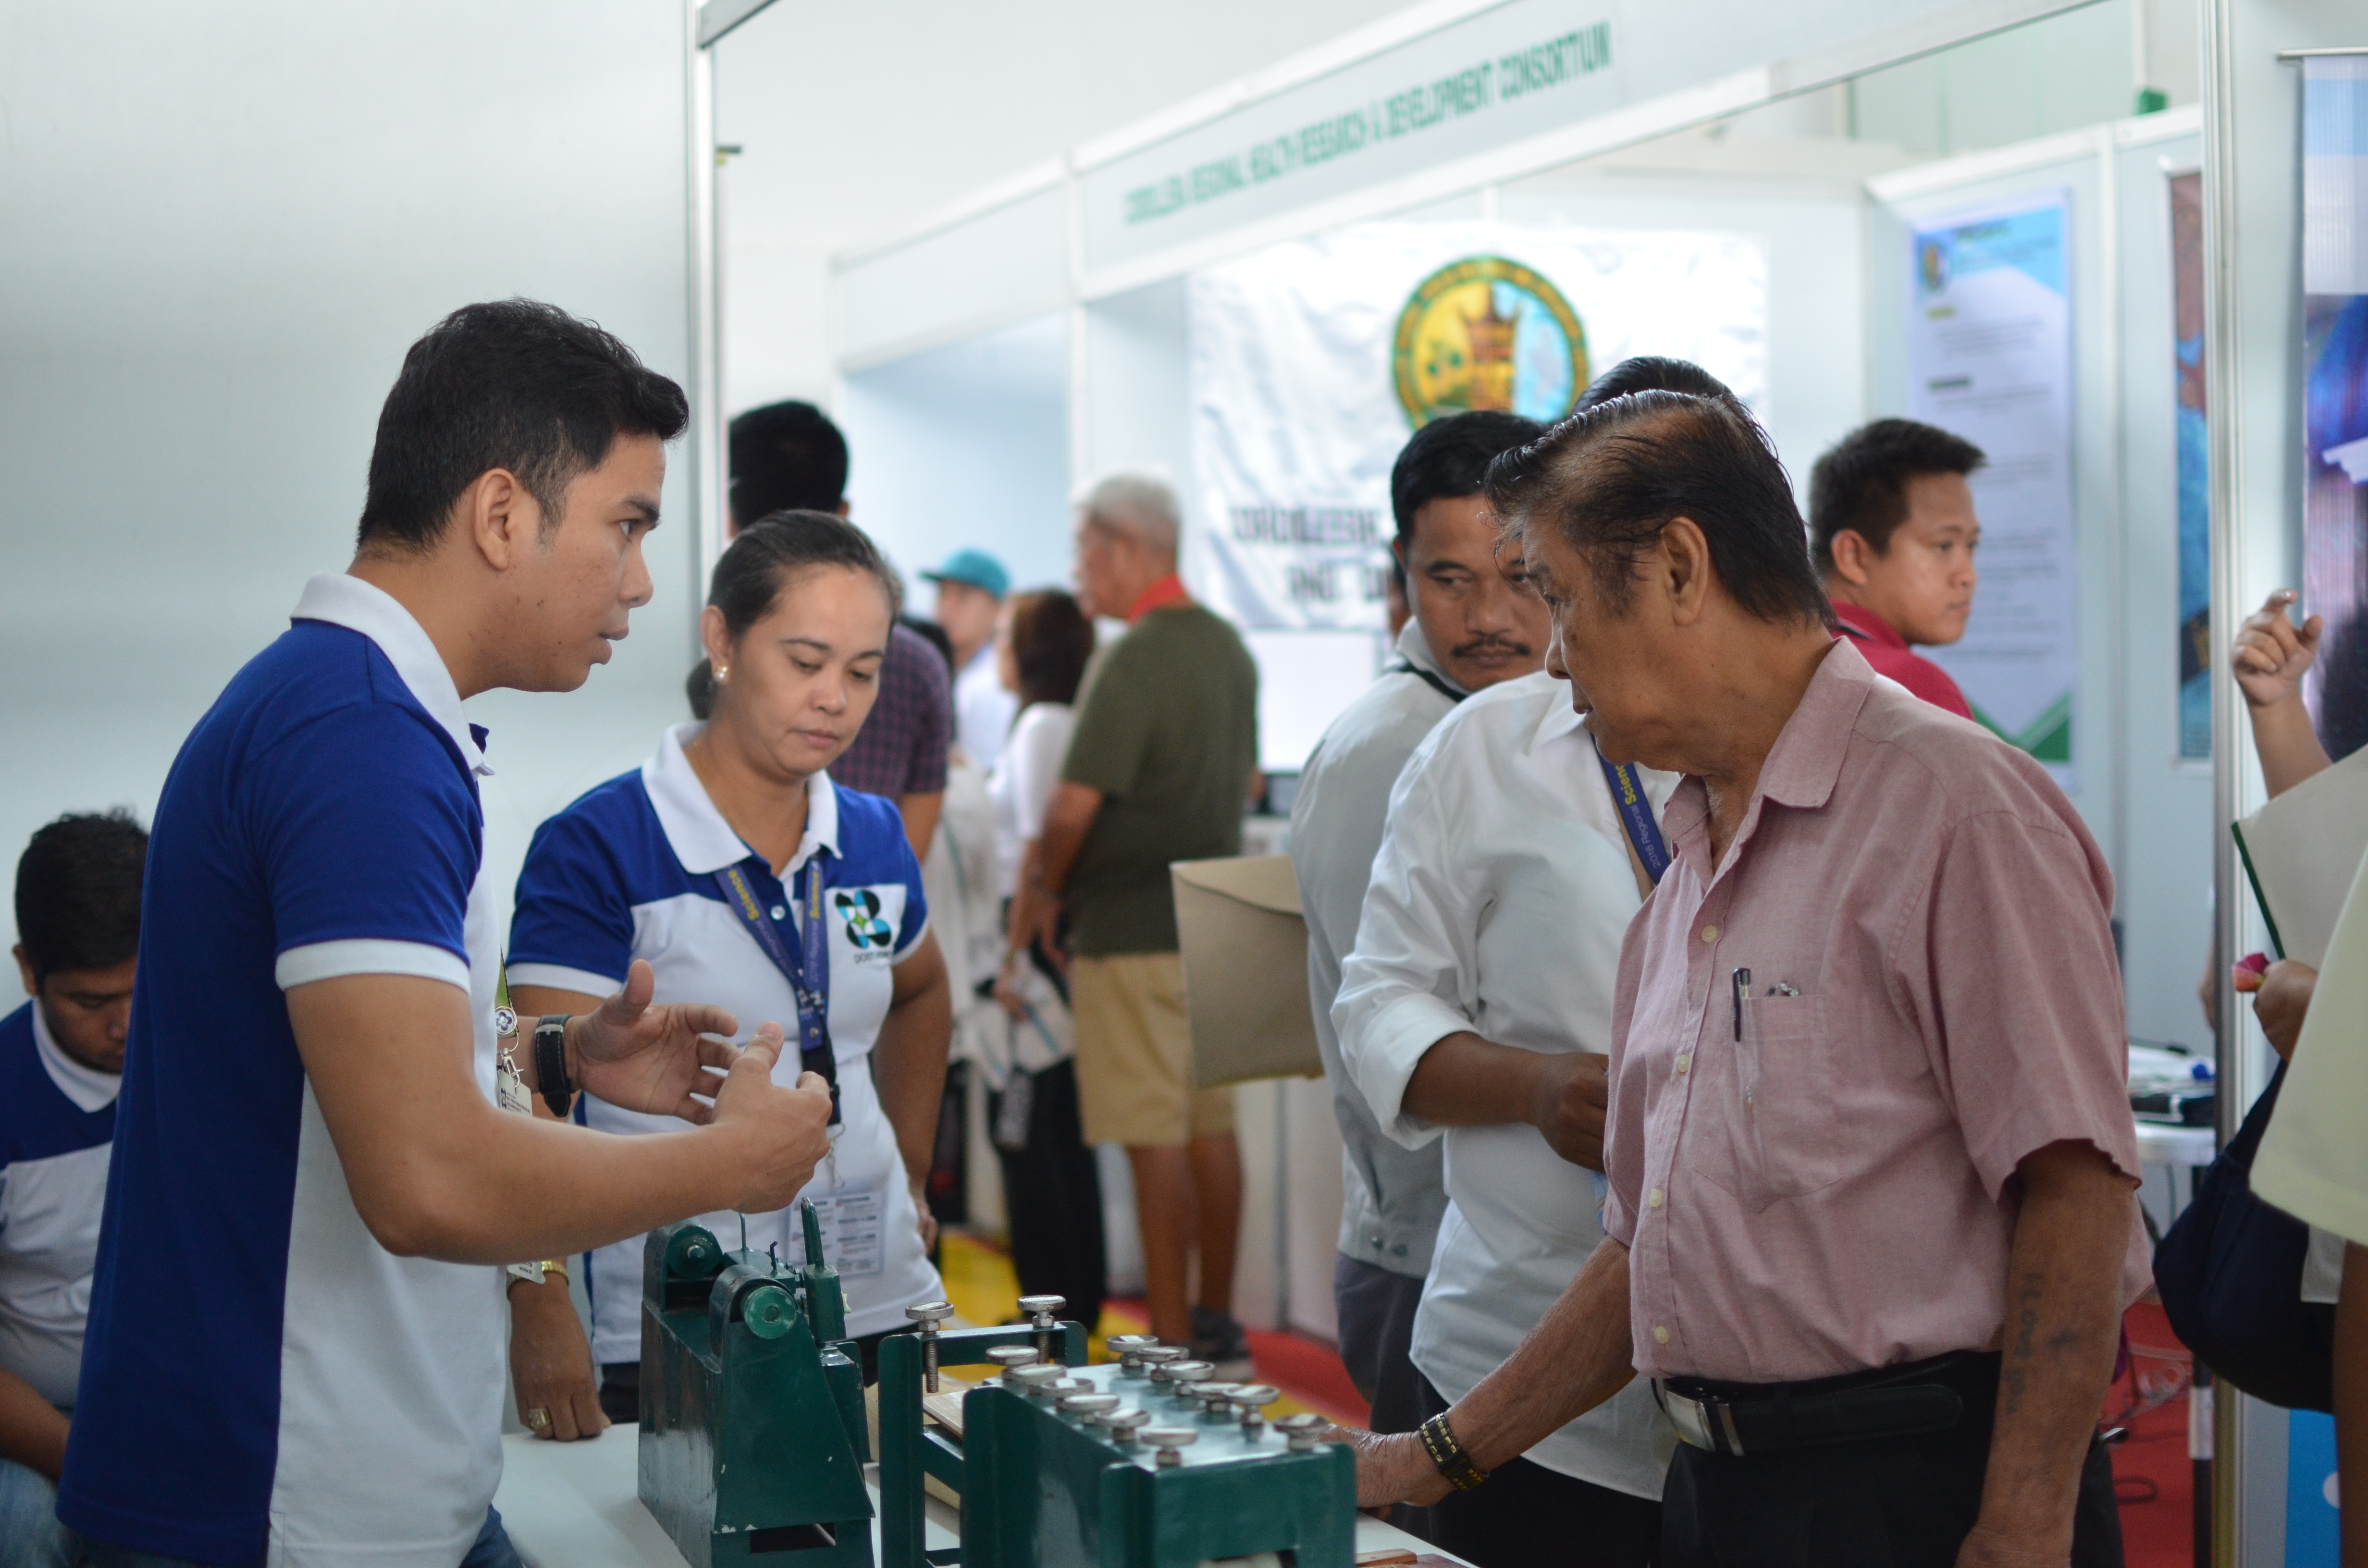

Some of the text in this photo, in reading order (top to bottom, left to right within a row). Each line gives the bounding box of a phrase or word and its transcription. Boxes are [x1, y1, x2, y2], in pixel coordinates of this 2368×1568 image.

[1498, 19, 1611, 100] CONSORTIUM
[1629, 804, 1652, 844] Regional
[728, 870, 760, 920] Science
